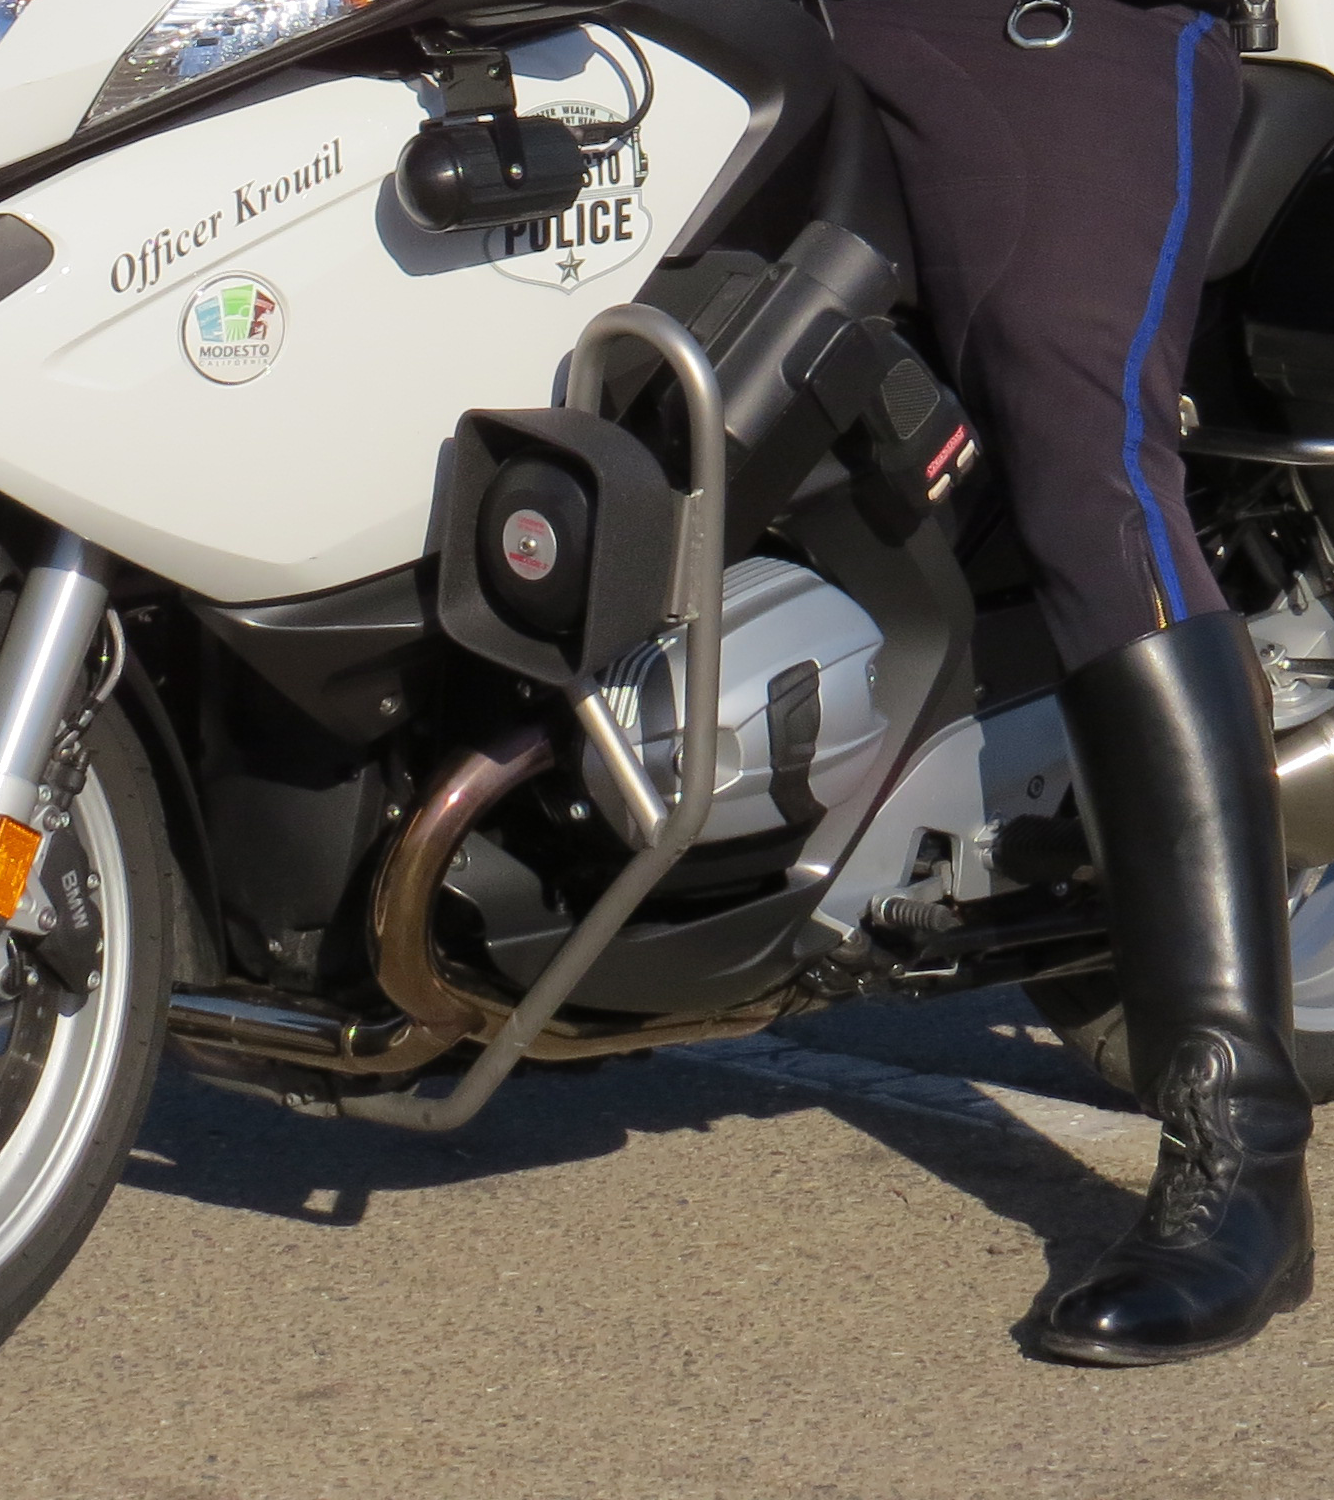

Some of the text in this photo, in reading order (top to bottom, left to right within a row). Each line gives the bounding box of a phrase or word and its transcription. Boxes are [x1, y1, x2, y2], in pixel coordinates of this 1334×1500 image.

[561, 105, 596, 117] WEALTH
[111, 137, 344, 294] Officer Kroutil
[505, 197, 633, 256] POLICE
[199, 344, 270, 358] MODESTO
[61, 869, 90, 930] BMW
